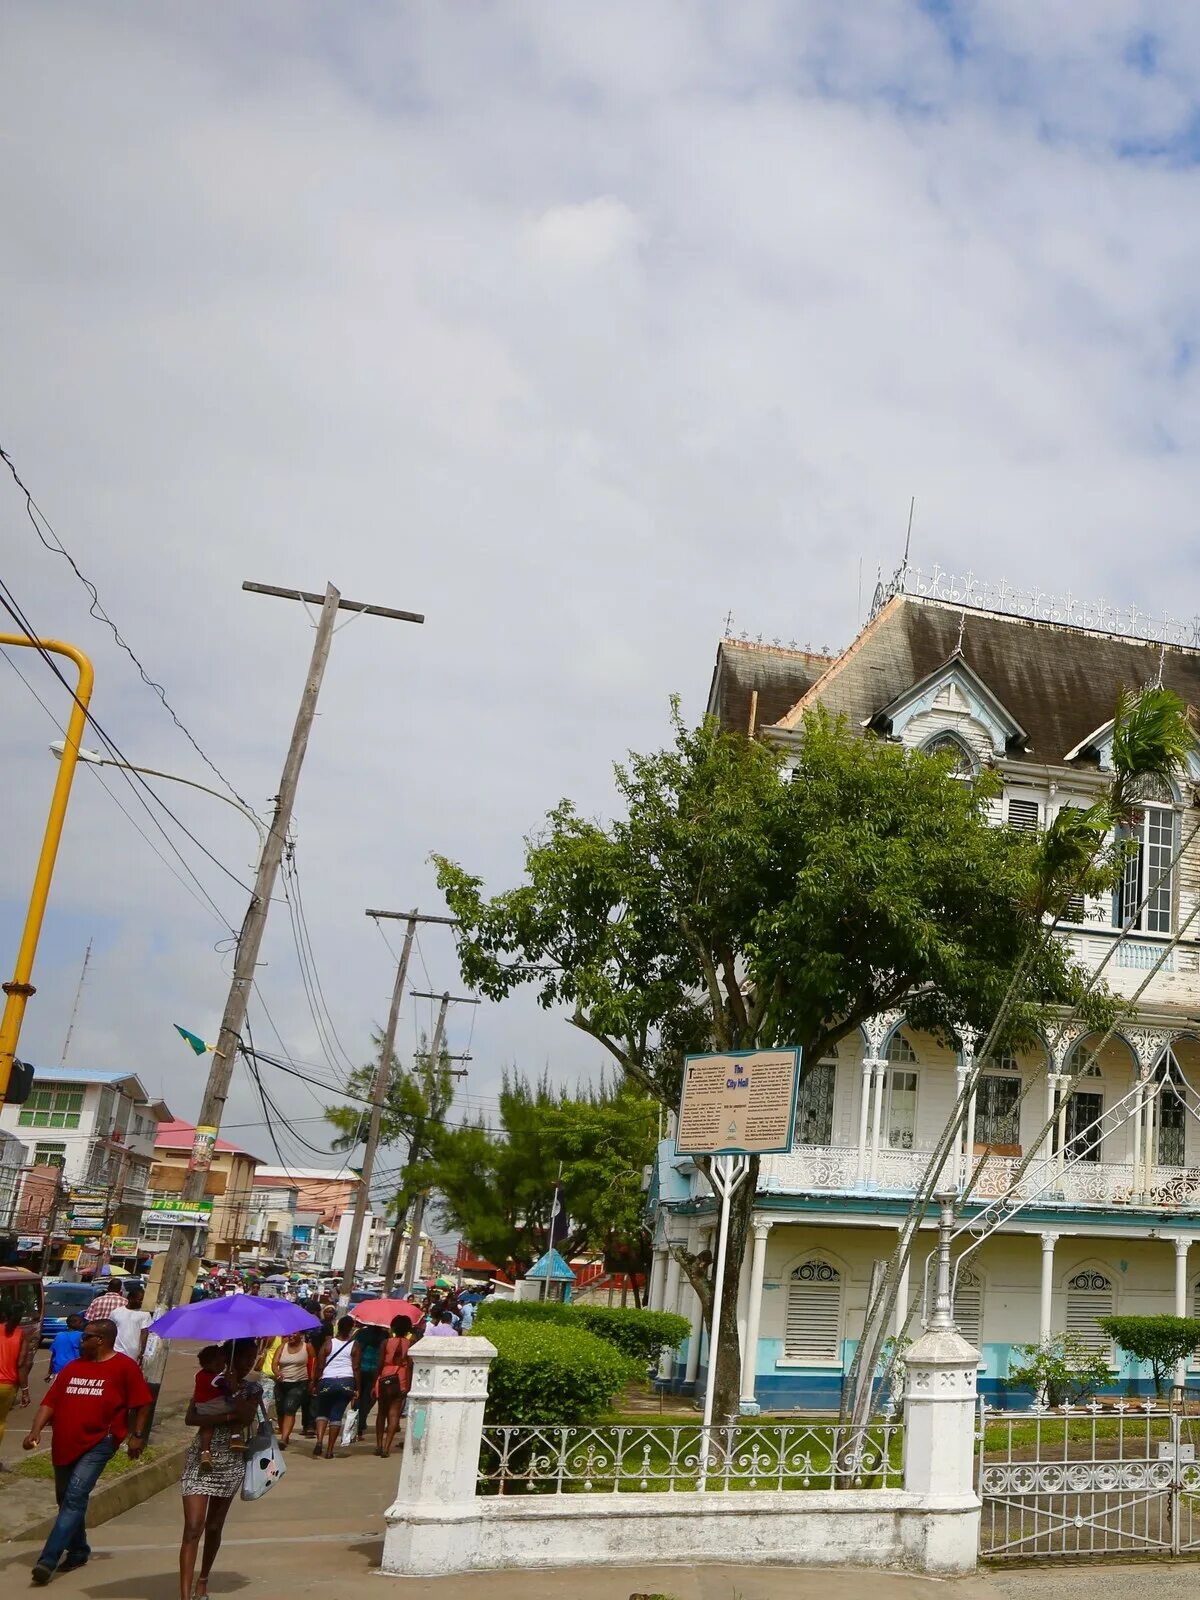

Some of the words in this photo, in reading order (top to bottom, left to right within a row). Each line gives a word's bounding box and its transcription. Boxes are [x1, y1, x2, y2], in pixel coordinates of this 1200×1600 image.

[734, 1065, 743, 1074] The
[726, 1079, 737, 1090] City
[738, 1078, 749, 1088] Hall
[969, 1097, 1136, 1239] CO-OPRATIVE
[152, 1200, 162, 1209] IT
[163, 1201, 173, 1209] IS
[175, 1202, 200, 1211] TIME
[69, 1377, 88, 1386] ANNOY
[87, 1379, 97, 1387] ME
[95, 1379, 106, 1387] AT
[78, 1387, 90, 1395] OWN
[89, 1388, 104, 1396] RISK
